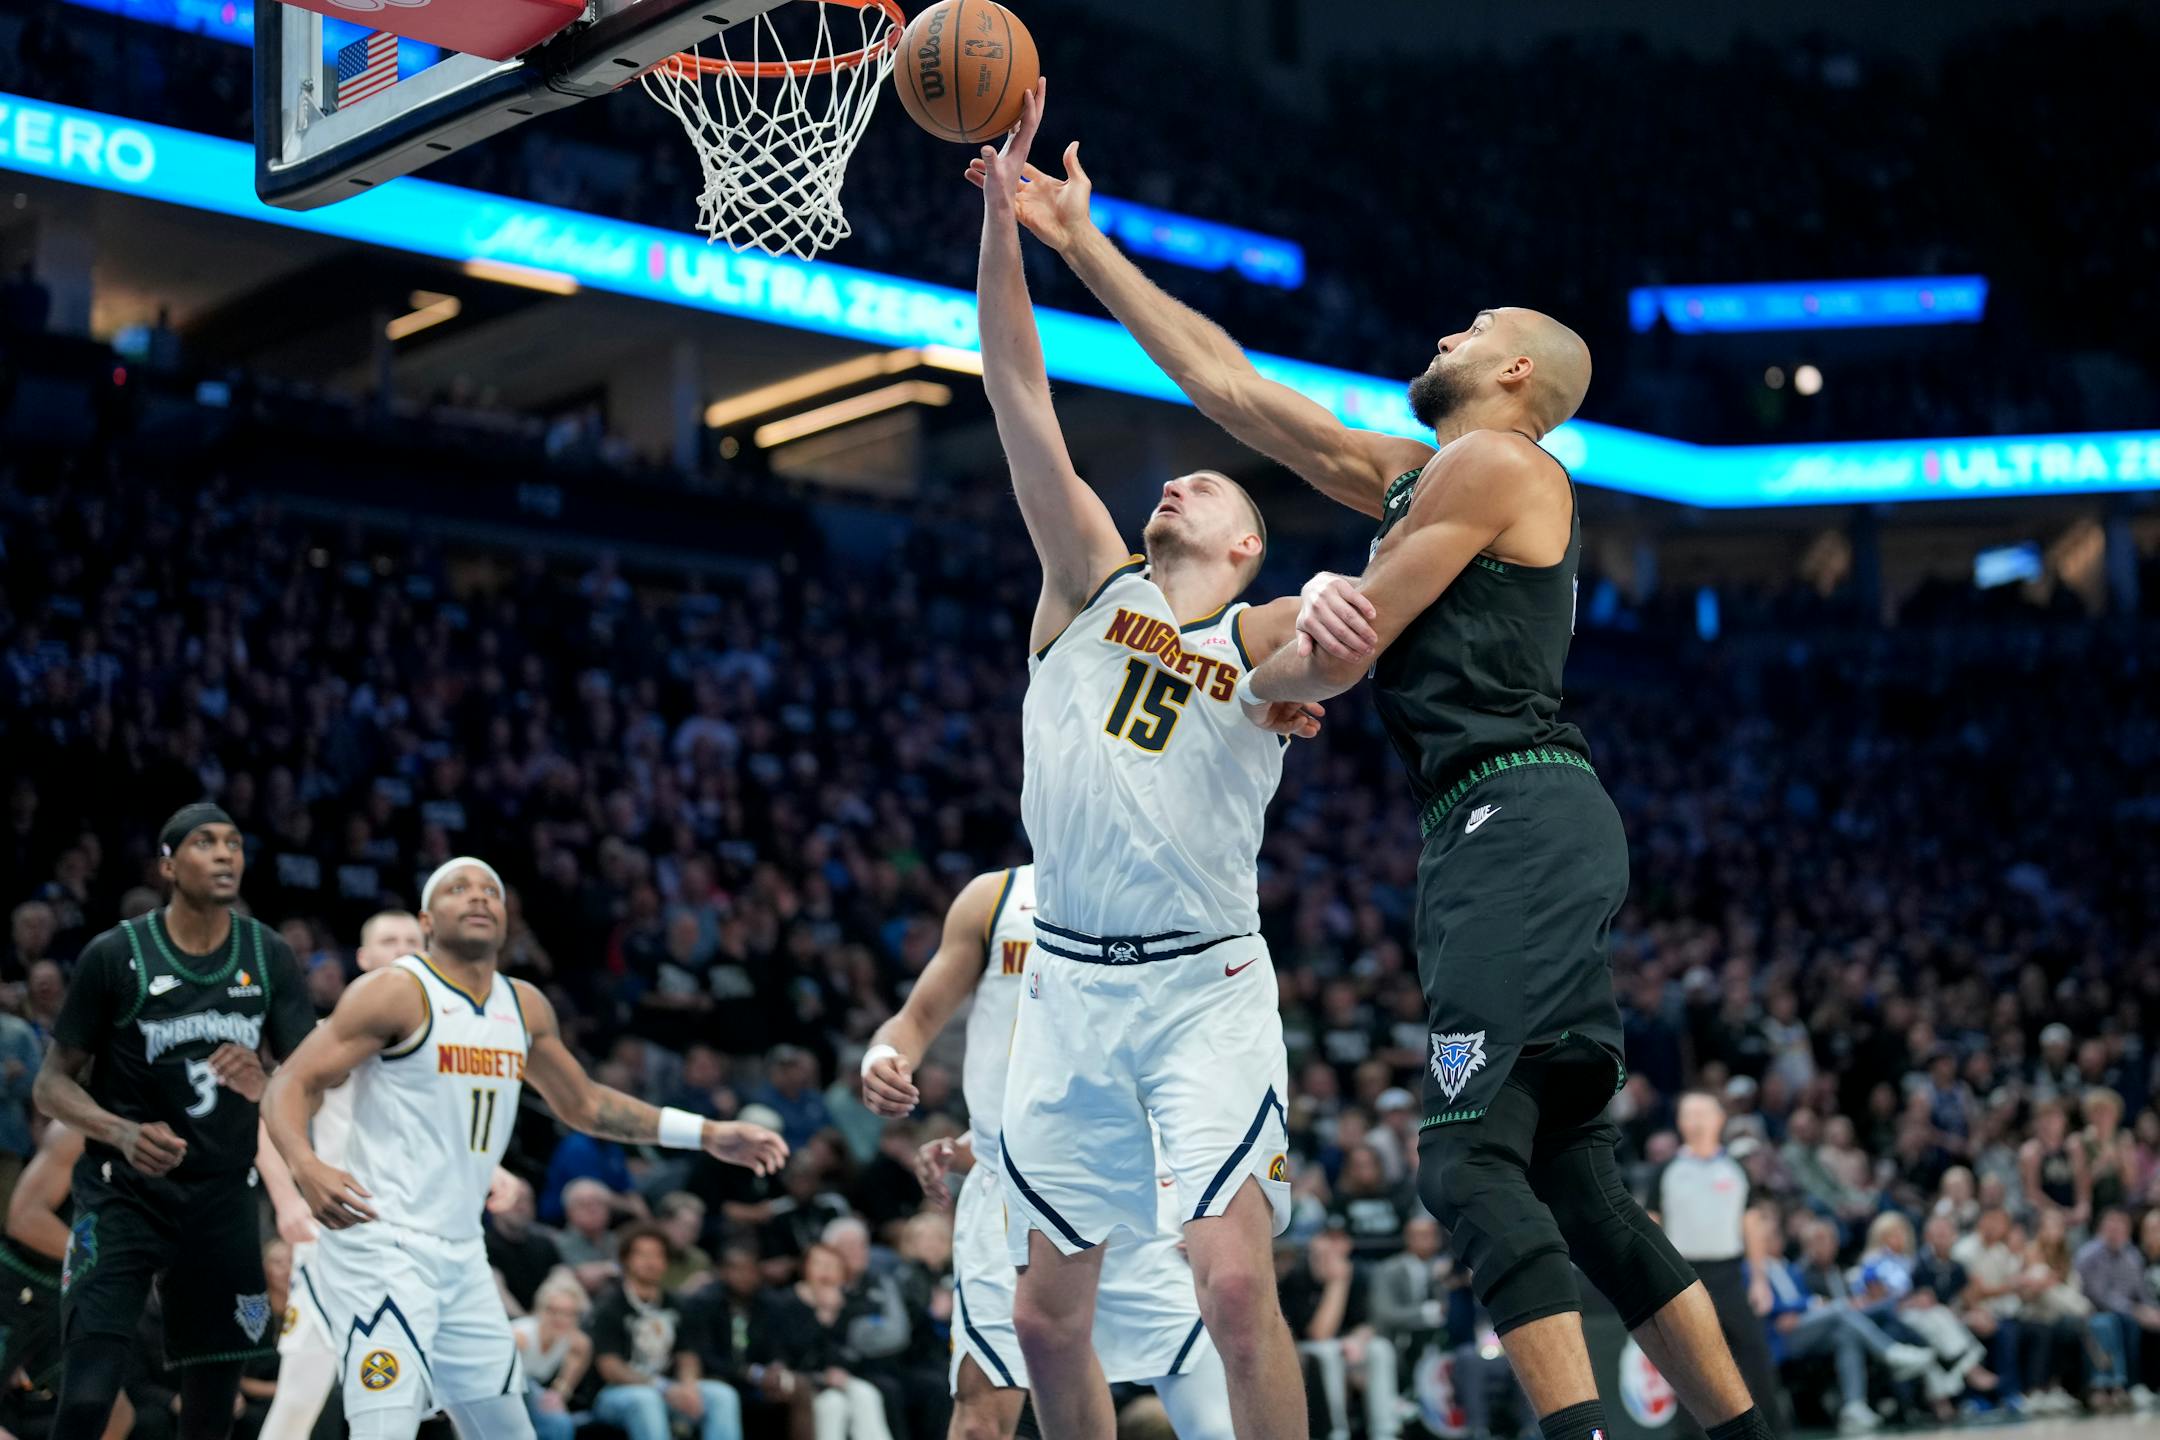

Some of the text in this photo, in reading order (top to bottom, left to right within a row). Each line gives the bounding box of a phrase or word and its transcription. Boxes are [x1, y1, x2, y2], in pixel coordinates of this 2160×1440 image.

[918, 8, 950, 101] Wilson
[0, 103, 155, 183] ERO
[670, 245, 841, 321] ULTRA
[1944, 441, 2108, 490] ULTRA
[1104, 607, 1240, 703] NUGGETS
[1104, 656, 1195, 754] 15
[1470, 804, 1492, 824] NIKE
[185, 1057, 218, 1119] 3
[437, 1043, 525, 1081] NUGGETS
[471, 1087, 497, 1152] 11
